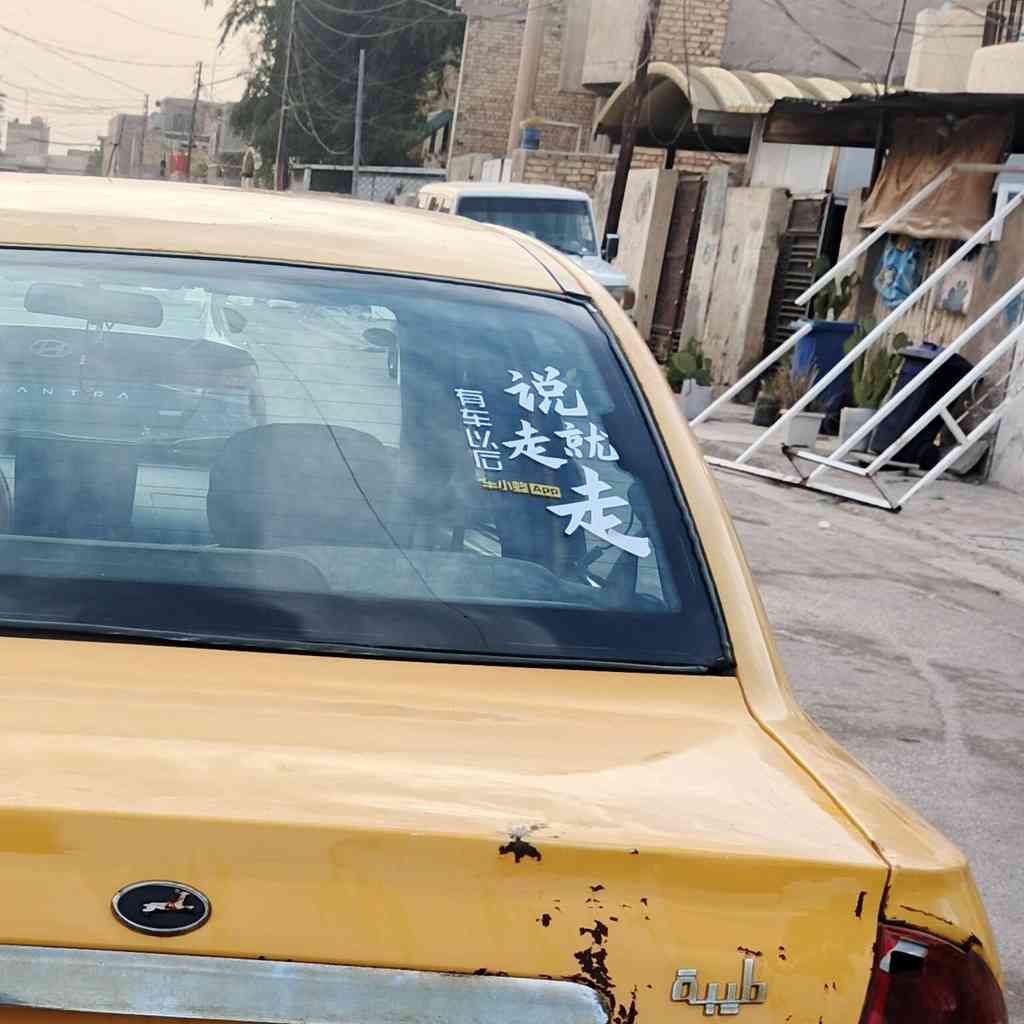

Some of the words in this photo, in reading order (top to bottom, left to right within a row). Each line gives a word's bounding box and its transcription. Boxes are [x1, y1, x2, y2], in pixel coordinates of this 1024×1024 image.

[454, 388, 503, 471] 有车以后
[671, 958, 768, 1016] طيبة
